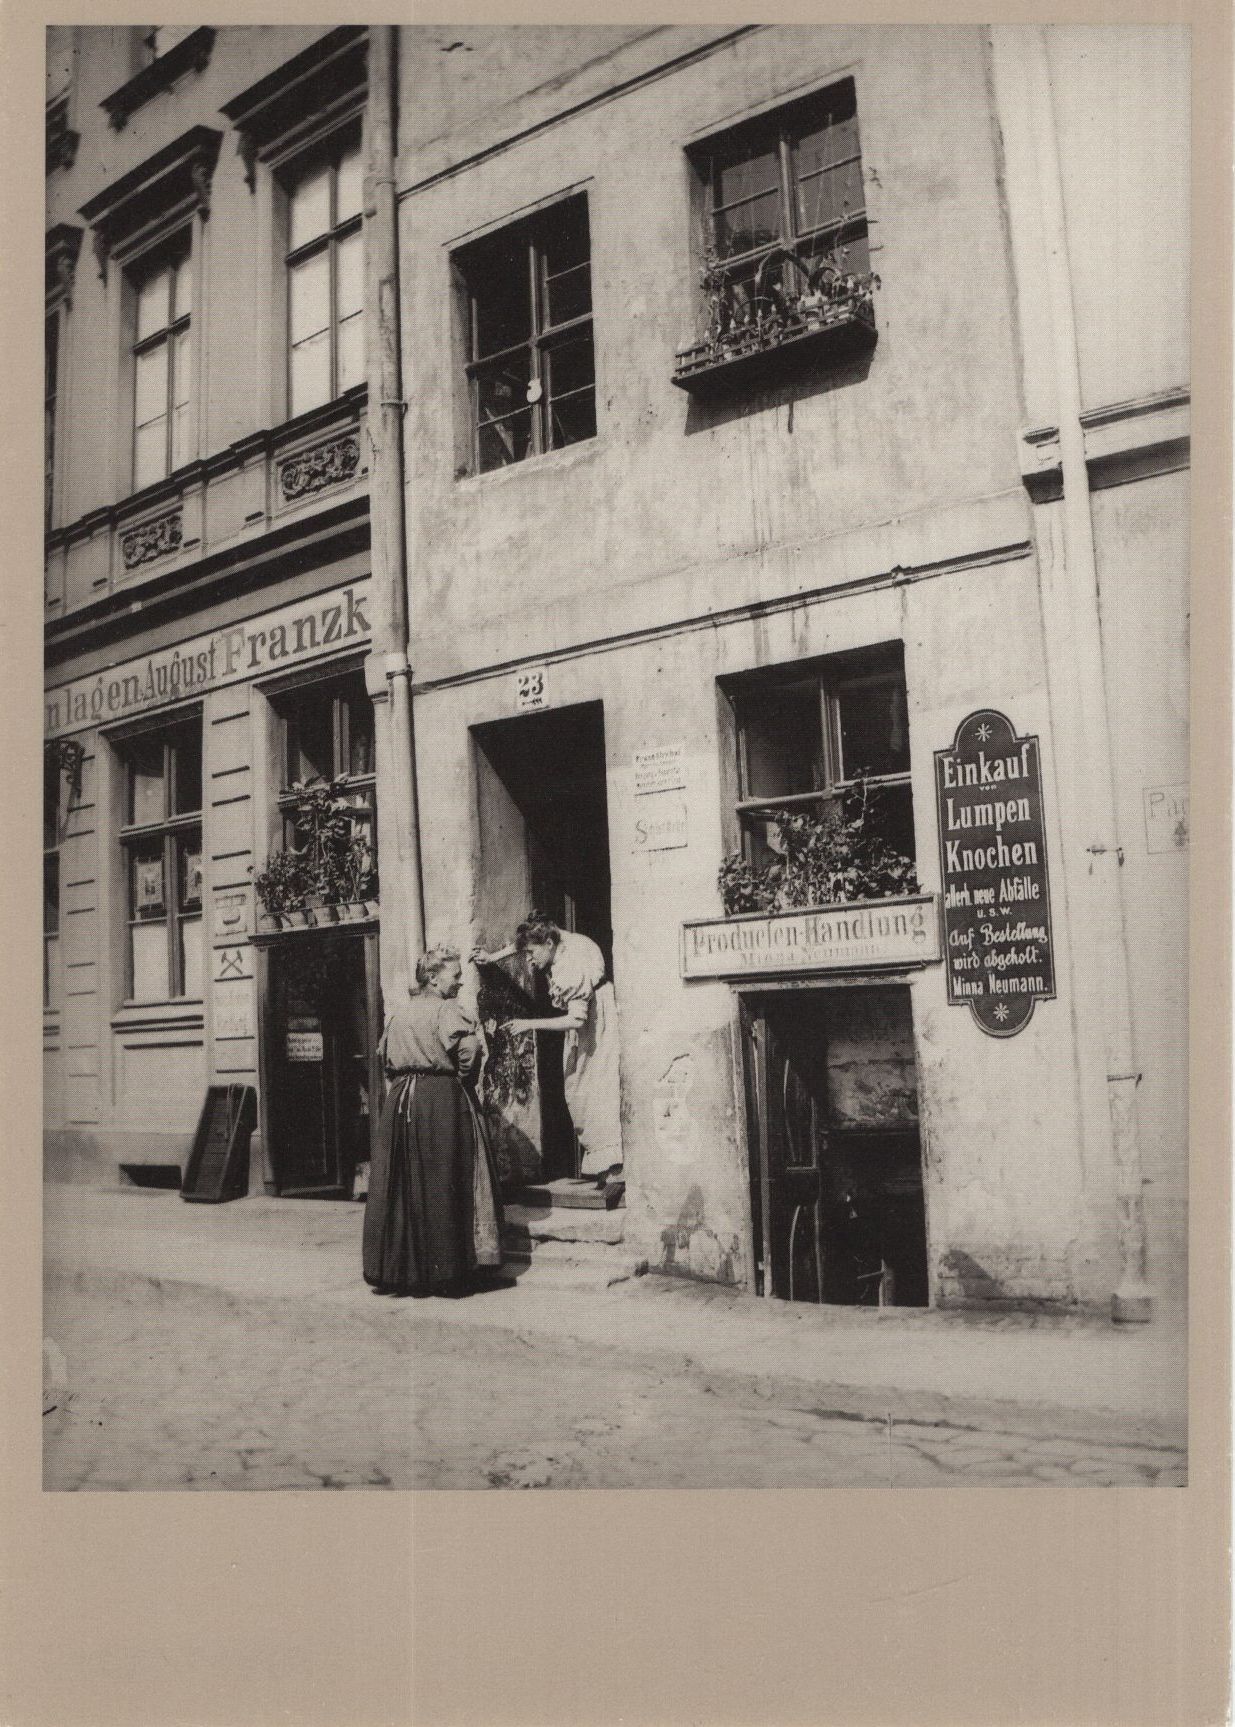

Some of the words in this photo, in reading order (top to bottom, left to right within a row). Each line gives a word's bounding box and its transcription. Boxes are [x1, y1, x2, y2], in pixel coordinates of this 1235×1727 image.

[142, 638, 217, 702] August
[943, 743, 1030, 789] Einkauf
[946, 797, 1032, 832] Lumpen
[945, 834, 1039, 873] Knochen
[999, 875, 1041, 903] Abfälle
[980, 921, 1049, 946] Bestellung
[953, 951, 981, 971] wird
[952, 975, 984, 997] Minna
